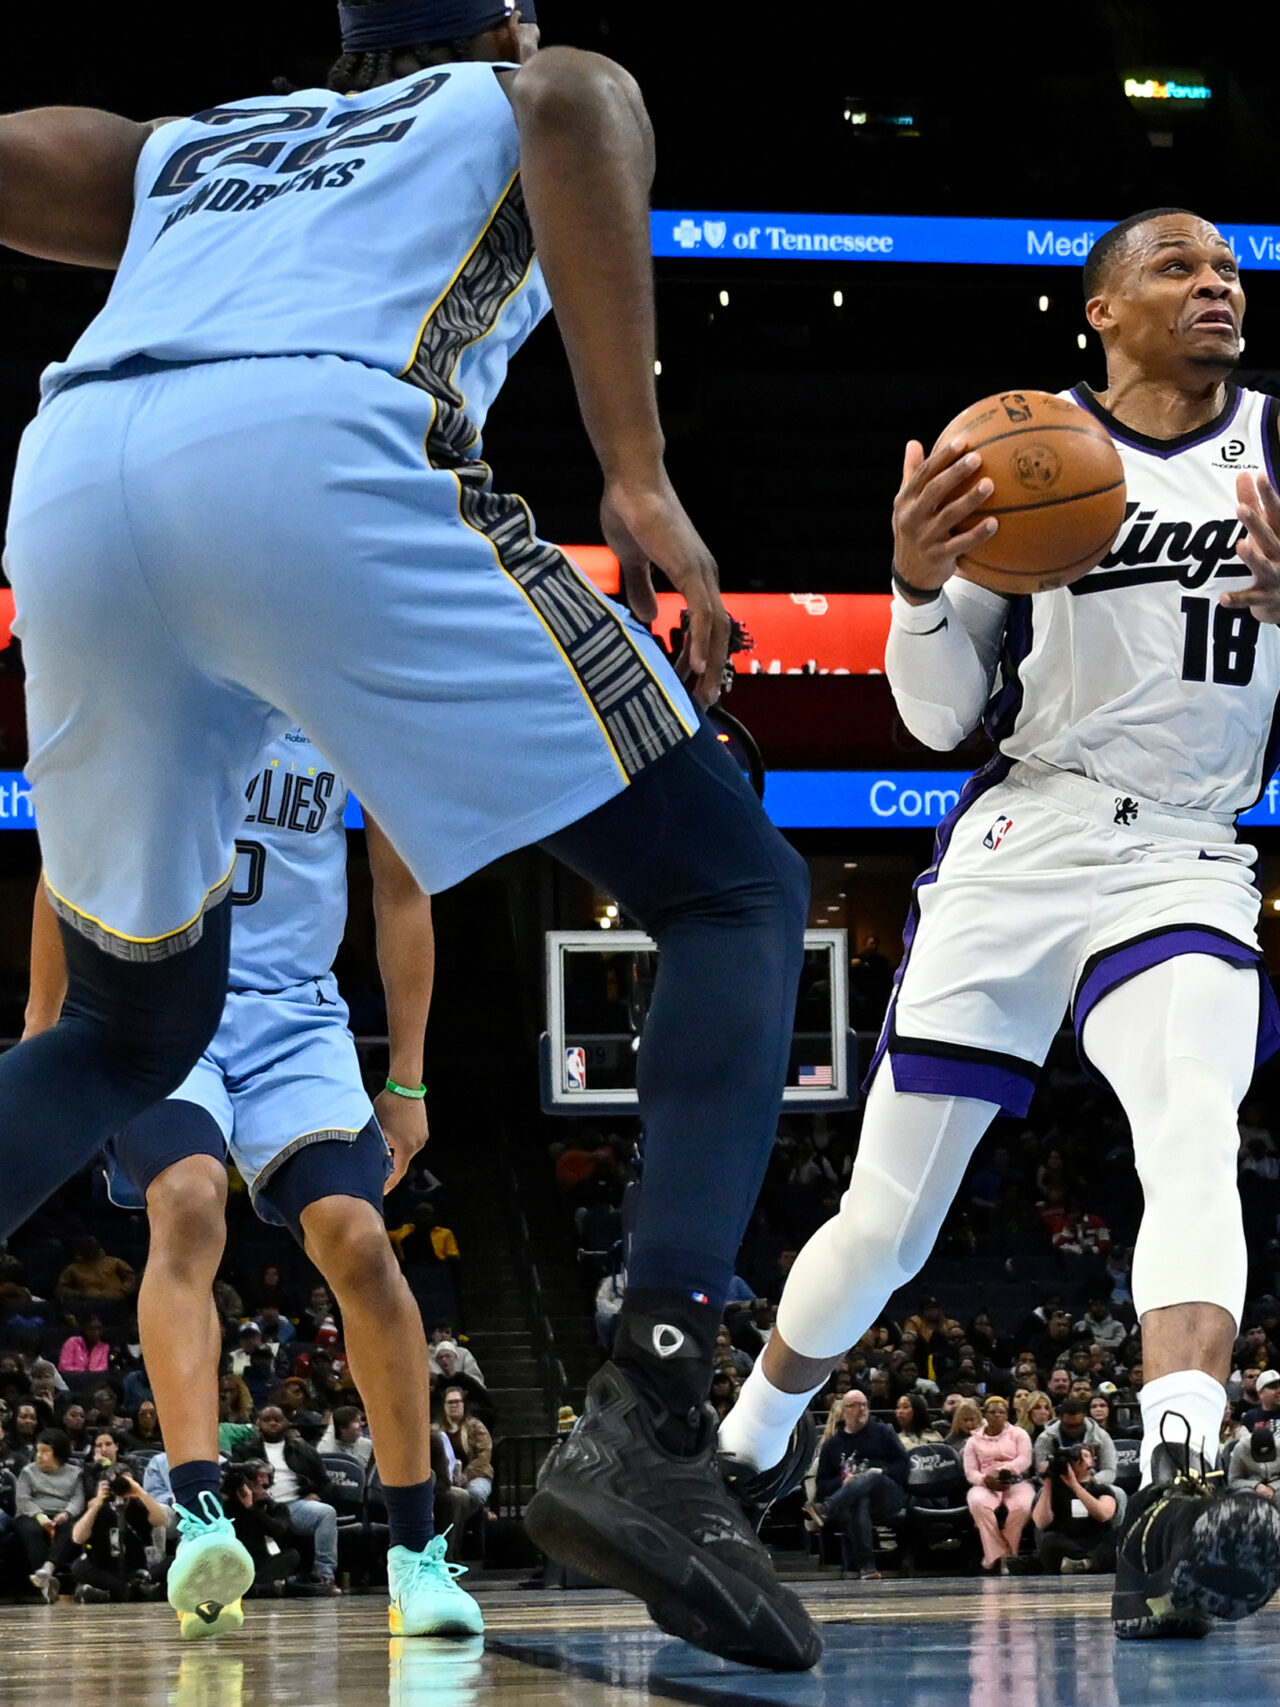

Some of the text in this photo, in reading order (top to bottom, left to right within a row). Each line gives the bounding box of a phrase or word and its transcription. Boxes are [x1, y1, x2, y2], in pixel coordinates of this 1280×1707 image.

[148, 72, 451, 198] 22
[733, 227, 893, 252] of Tennessee
[1180, 596, 1261, 687] 18
